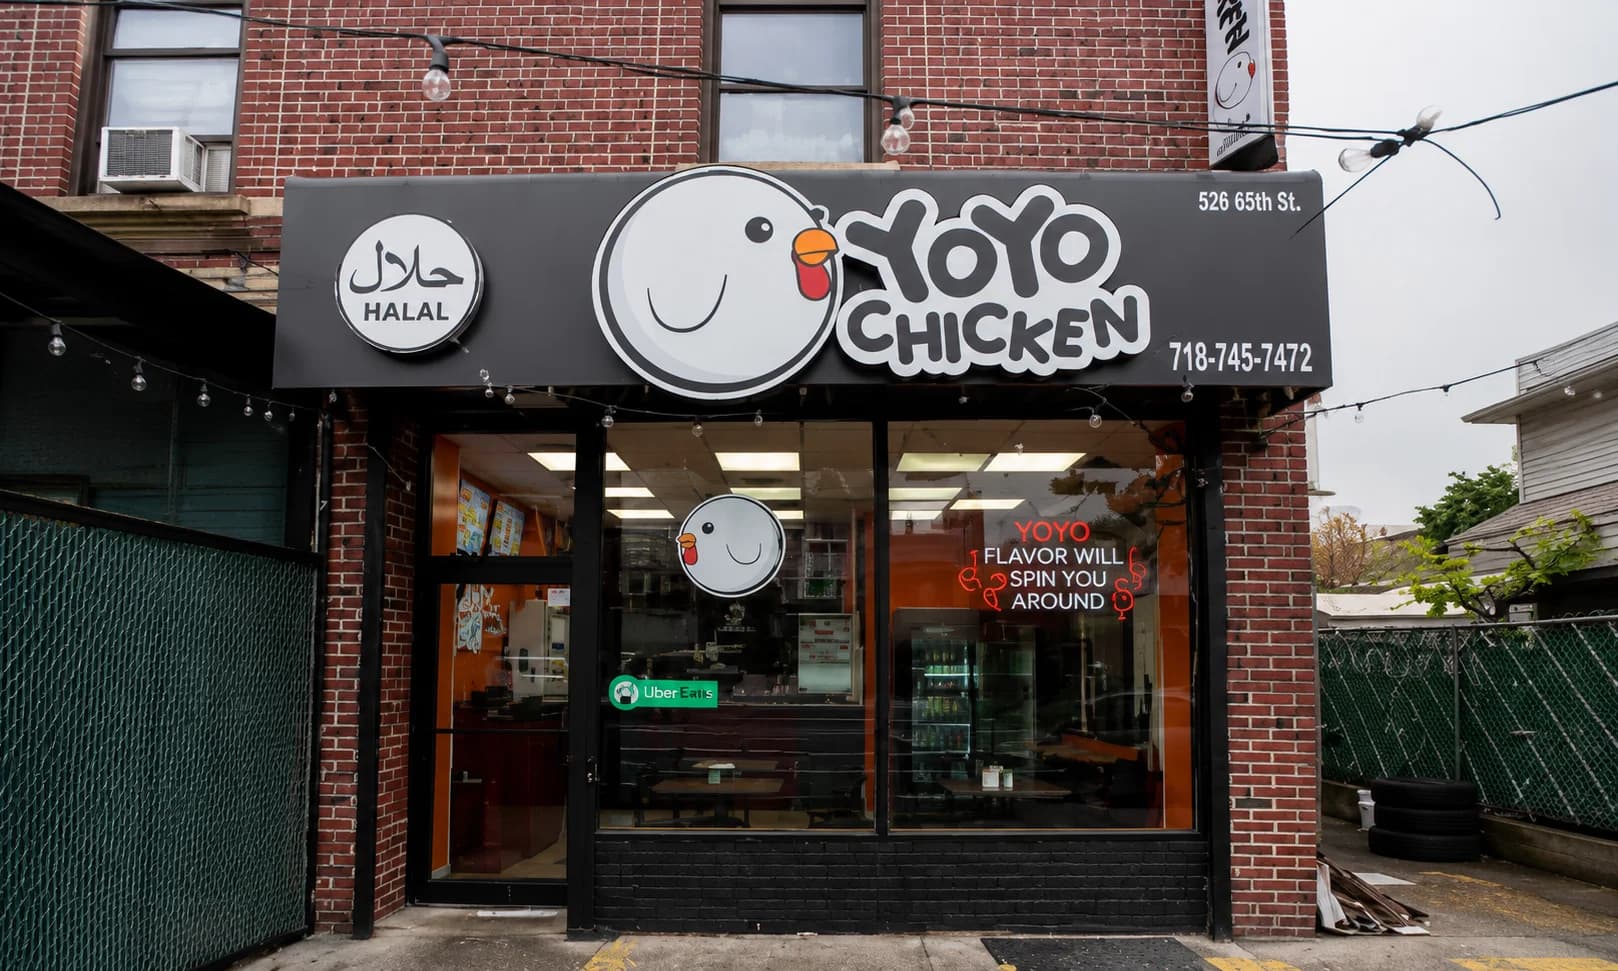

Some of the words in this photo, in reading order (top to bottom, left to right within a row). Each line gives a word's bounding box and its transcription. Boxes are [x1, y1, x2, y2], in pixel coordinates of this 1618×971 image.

[1199, 191, 1229, 211] 526
[1235, 191, 1272, 211] 65th
[1277, 191, 1301, 211] St.
[845, 194, 1110, 303] YOYO
[349, 239, 464, 294] حلال
[363, 302, 449, 321] HALAL
[847, 295, 1139, 366] CHICKEN
[1169, 341, 1313, 372] 718-745-7472
[1014, 520, 1091, 543] YOYO
[984, 547, 1068, 565] FLAVOR
[1073, 547, 1125, 565] WILL
[1010, 570, 1056, 588] SPIN
[1061, 570, 1107, 588] YOU
[1011, 592, 1105, 610] AROUND
[644, 685, 678, 699] Uber
